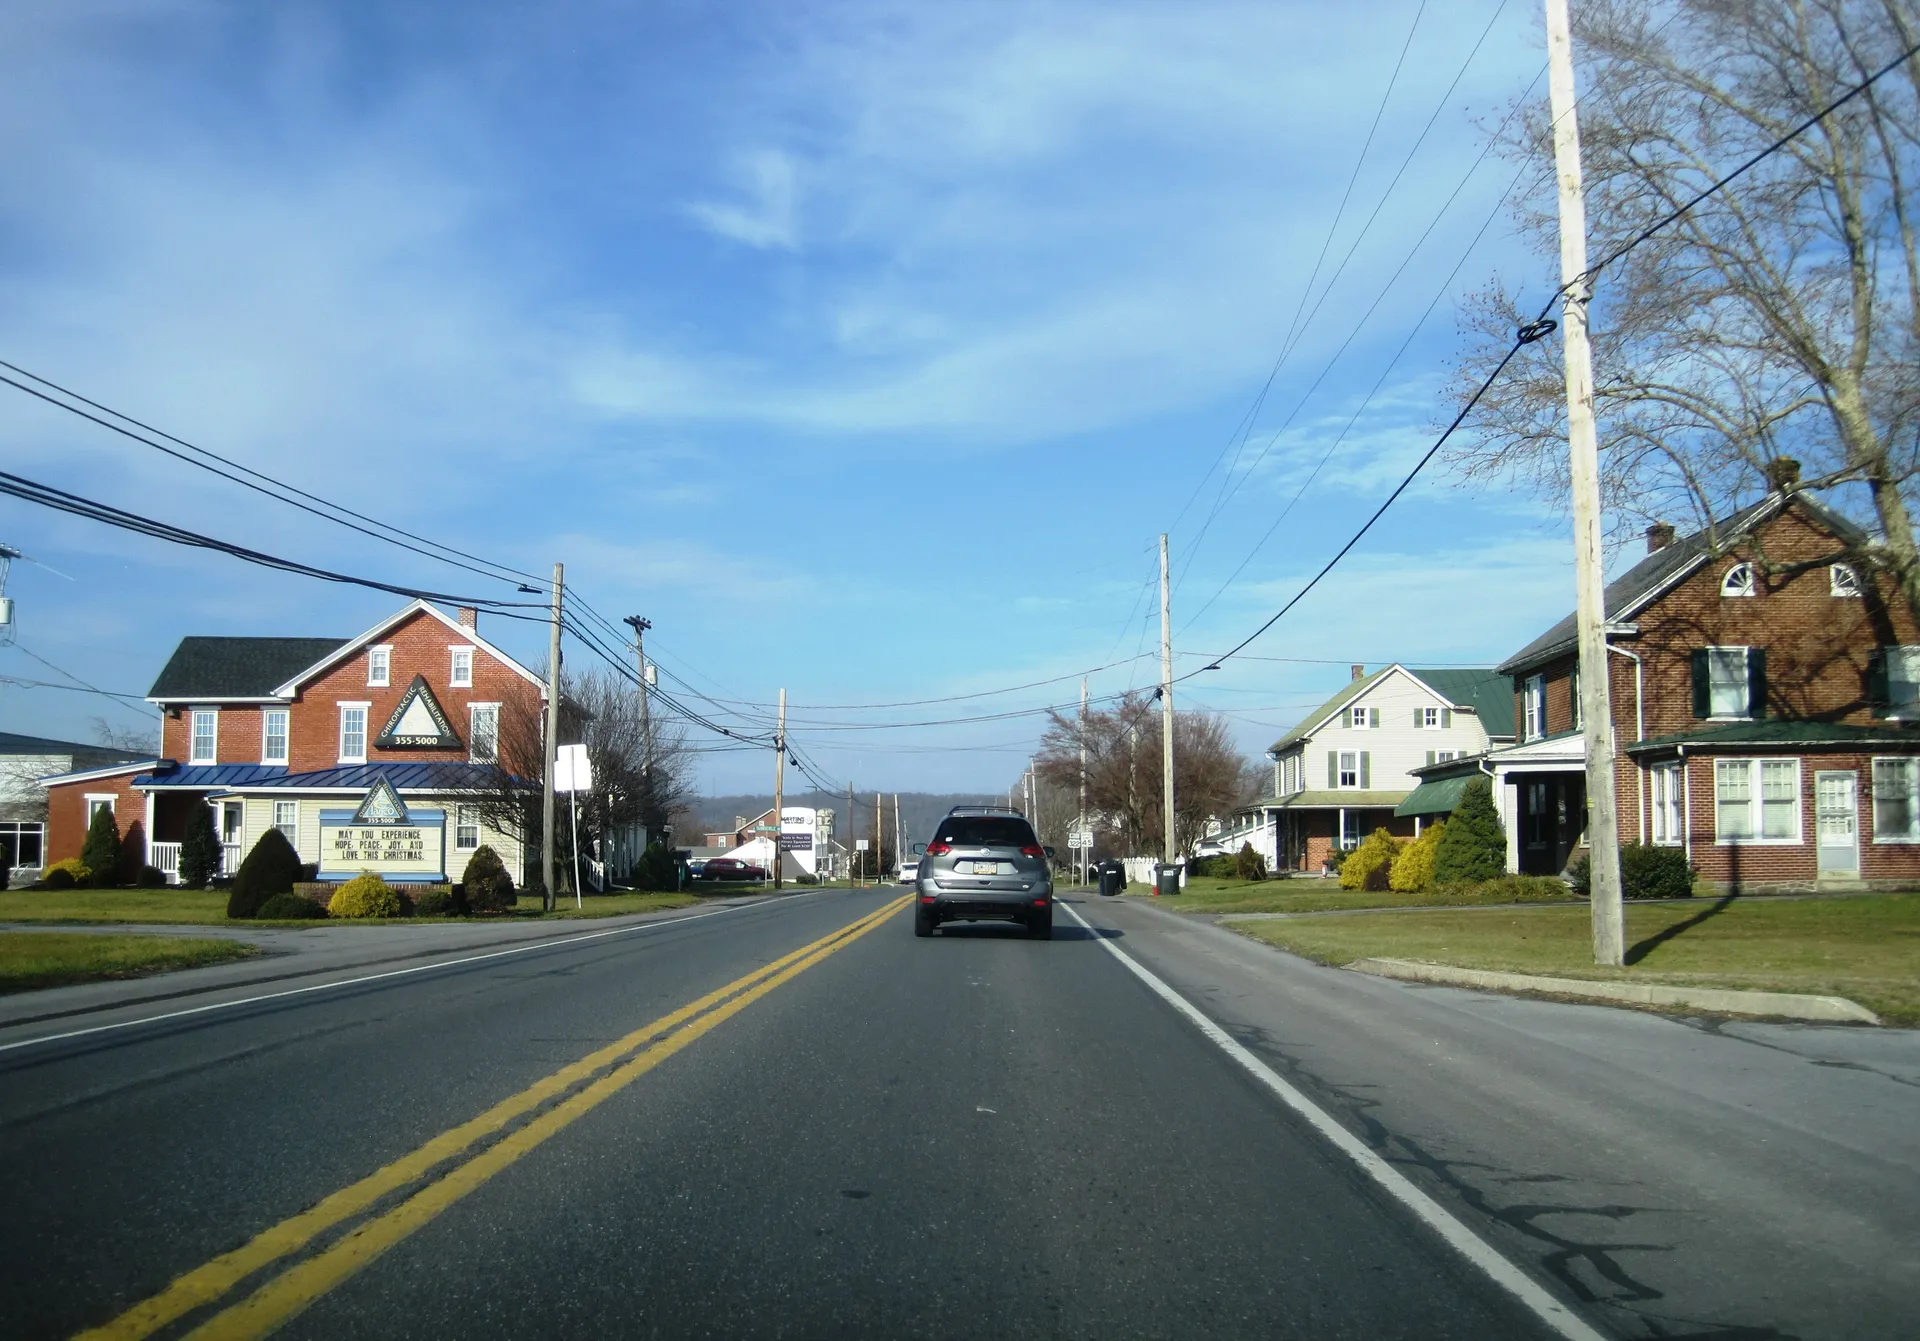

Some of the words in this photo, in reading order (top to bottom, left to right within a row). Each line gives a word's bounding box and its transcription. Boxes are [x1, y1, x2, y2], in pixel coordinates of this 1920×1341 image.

[381, 686, 417, 738] CHIROPRACTIC
[418, 686, 452, 737] REHABILITATION
[395, 737, 438, 745] 355-5000
[338, 830, 353, 840] MAY
[361, 830, 374, 840] YOU
[381, 830, 421, 840] EXPERIENCE
[410, 840, 423, 850] AND
[342, 850, 358, 860] LOVE
[364, 850, 379, 860] THIS
[383, 851, 425, 861] CHRISTMAS.
